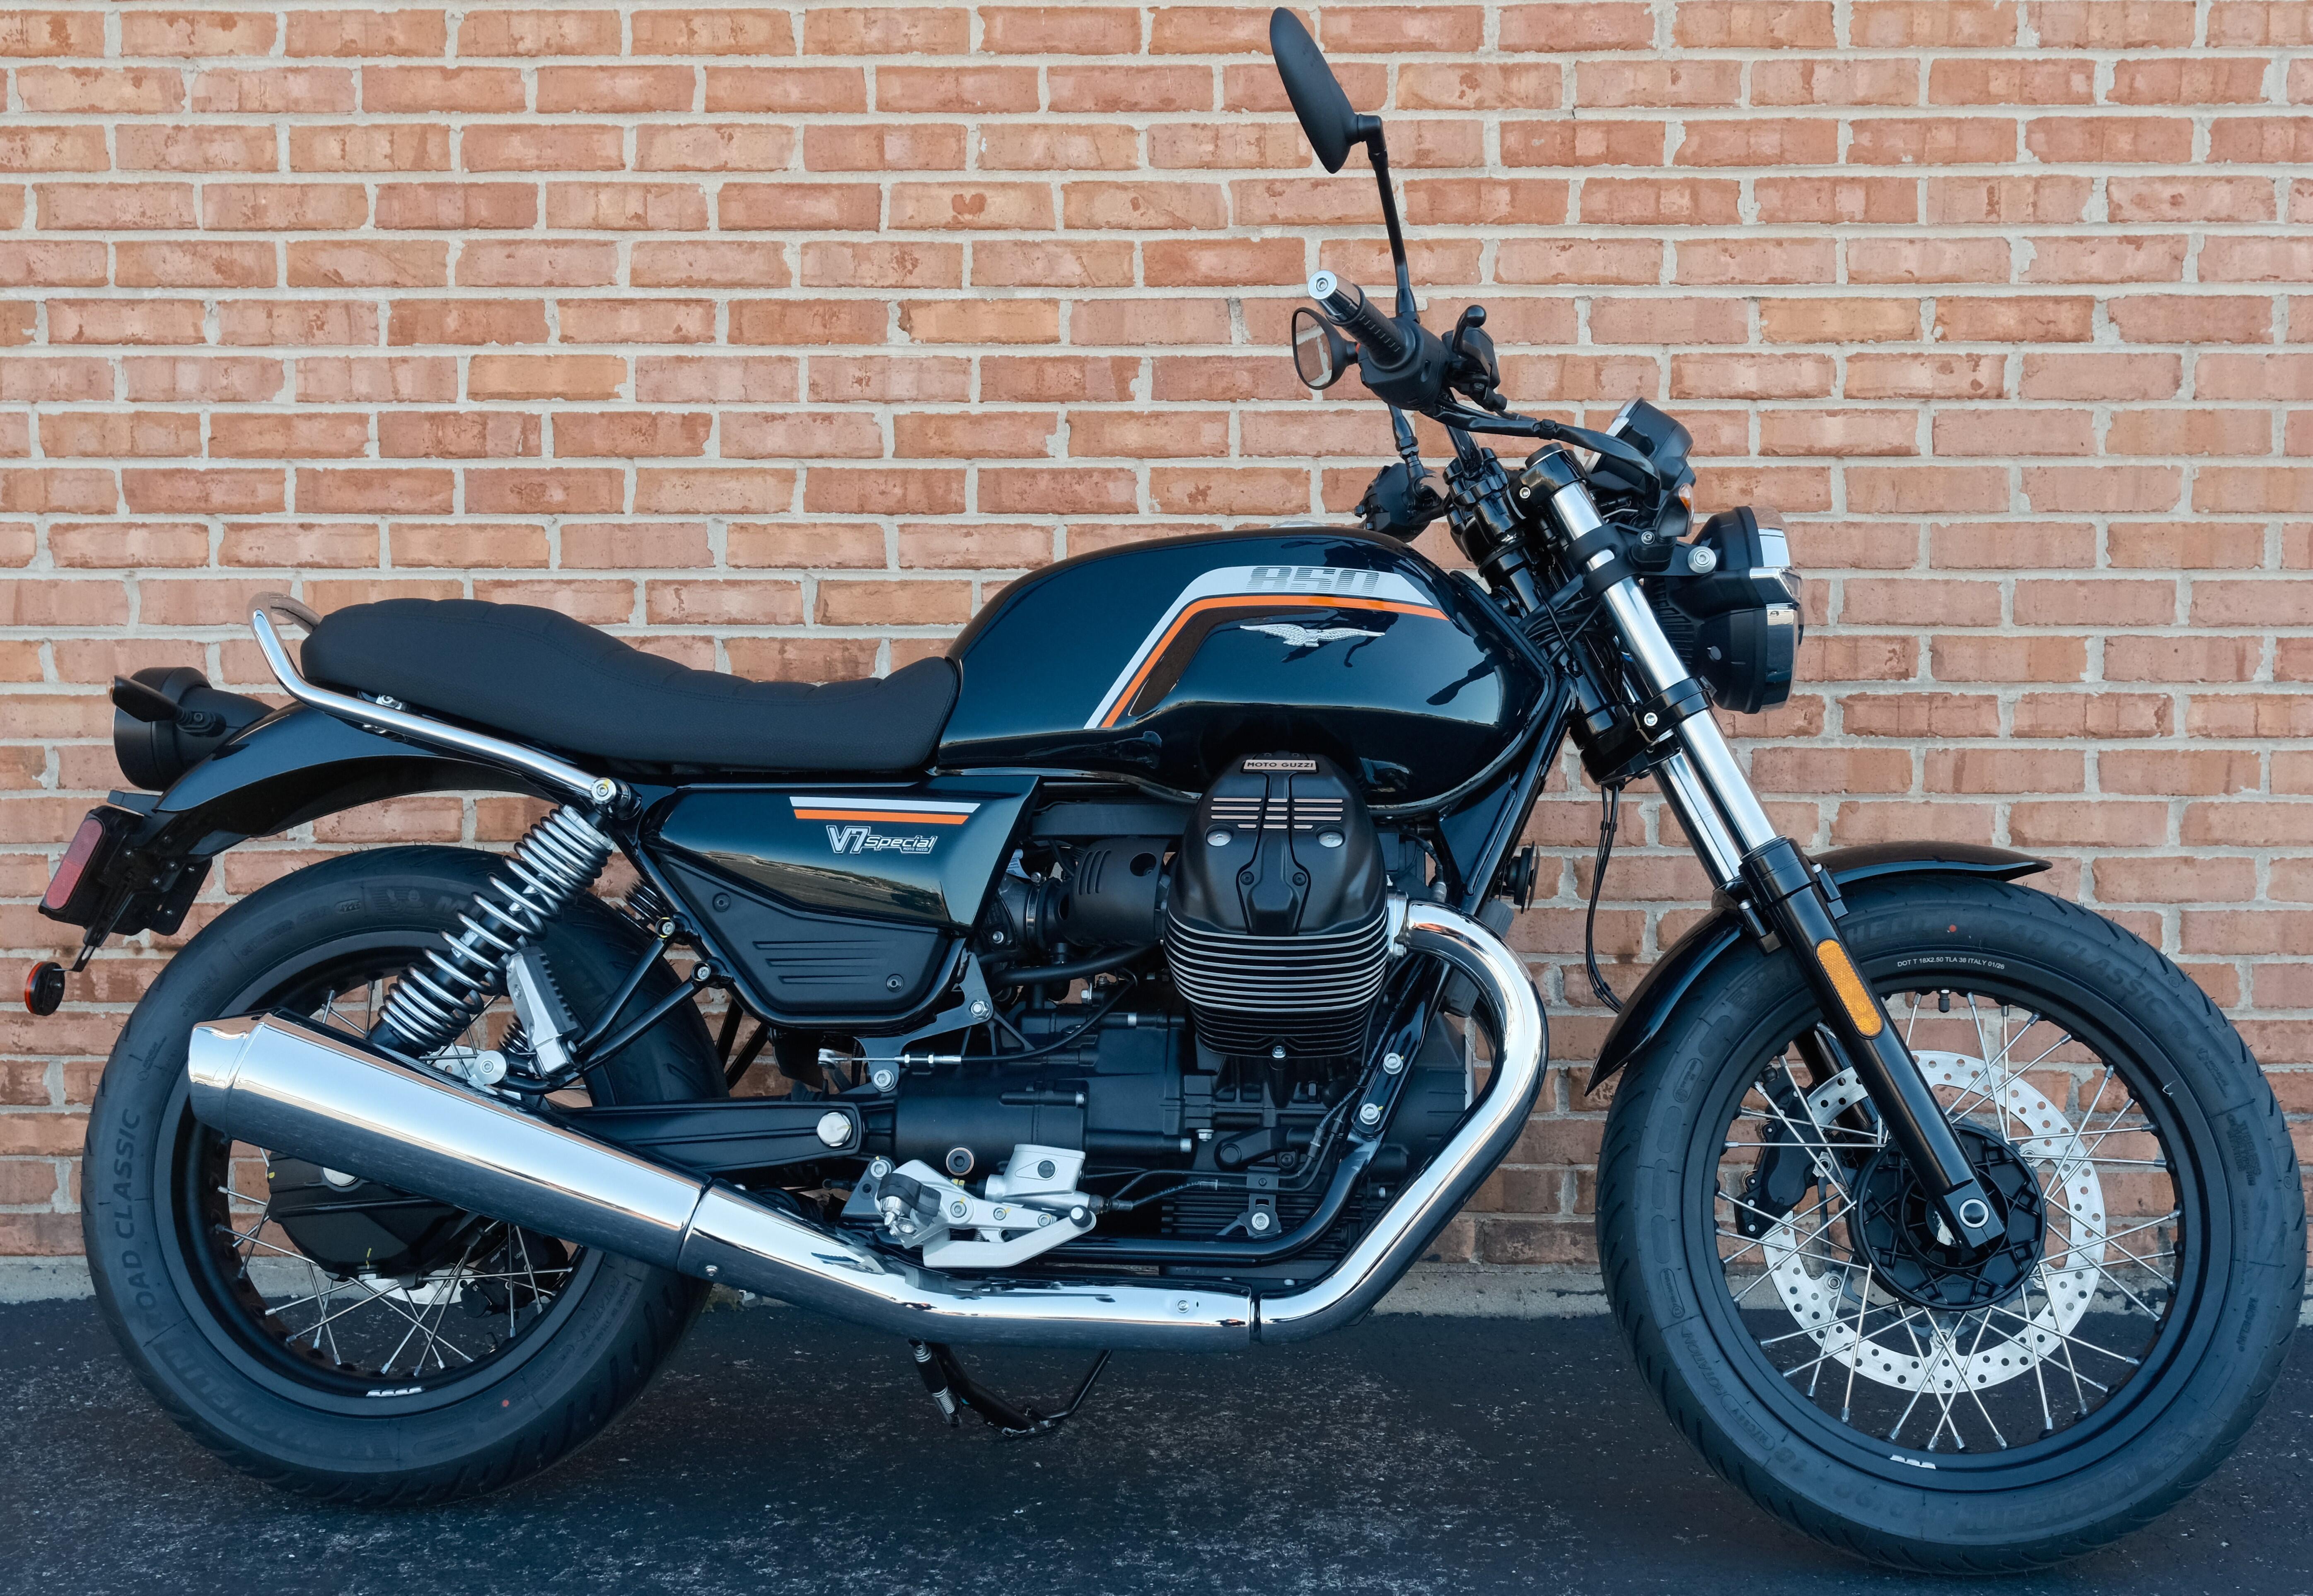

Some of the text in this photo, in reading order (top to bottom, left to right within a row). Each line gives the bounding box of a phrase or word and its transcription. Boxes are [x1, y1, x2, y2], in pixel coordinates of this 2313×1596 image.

[1245, 567, 1380, 595] 850
[827, 826, 935, 853] V7 Special
[114, 1108, 141, 1239] CLASSIC
[1683, 1331, 1727, 1398] ROTATION
